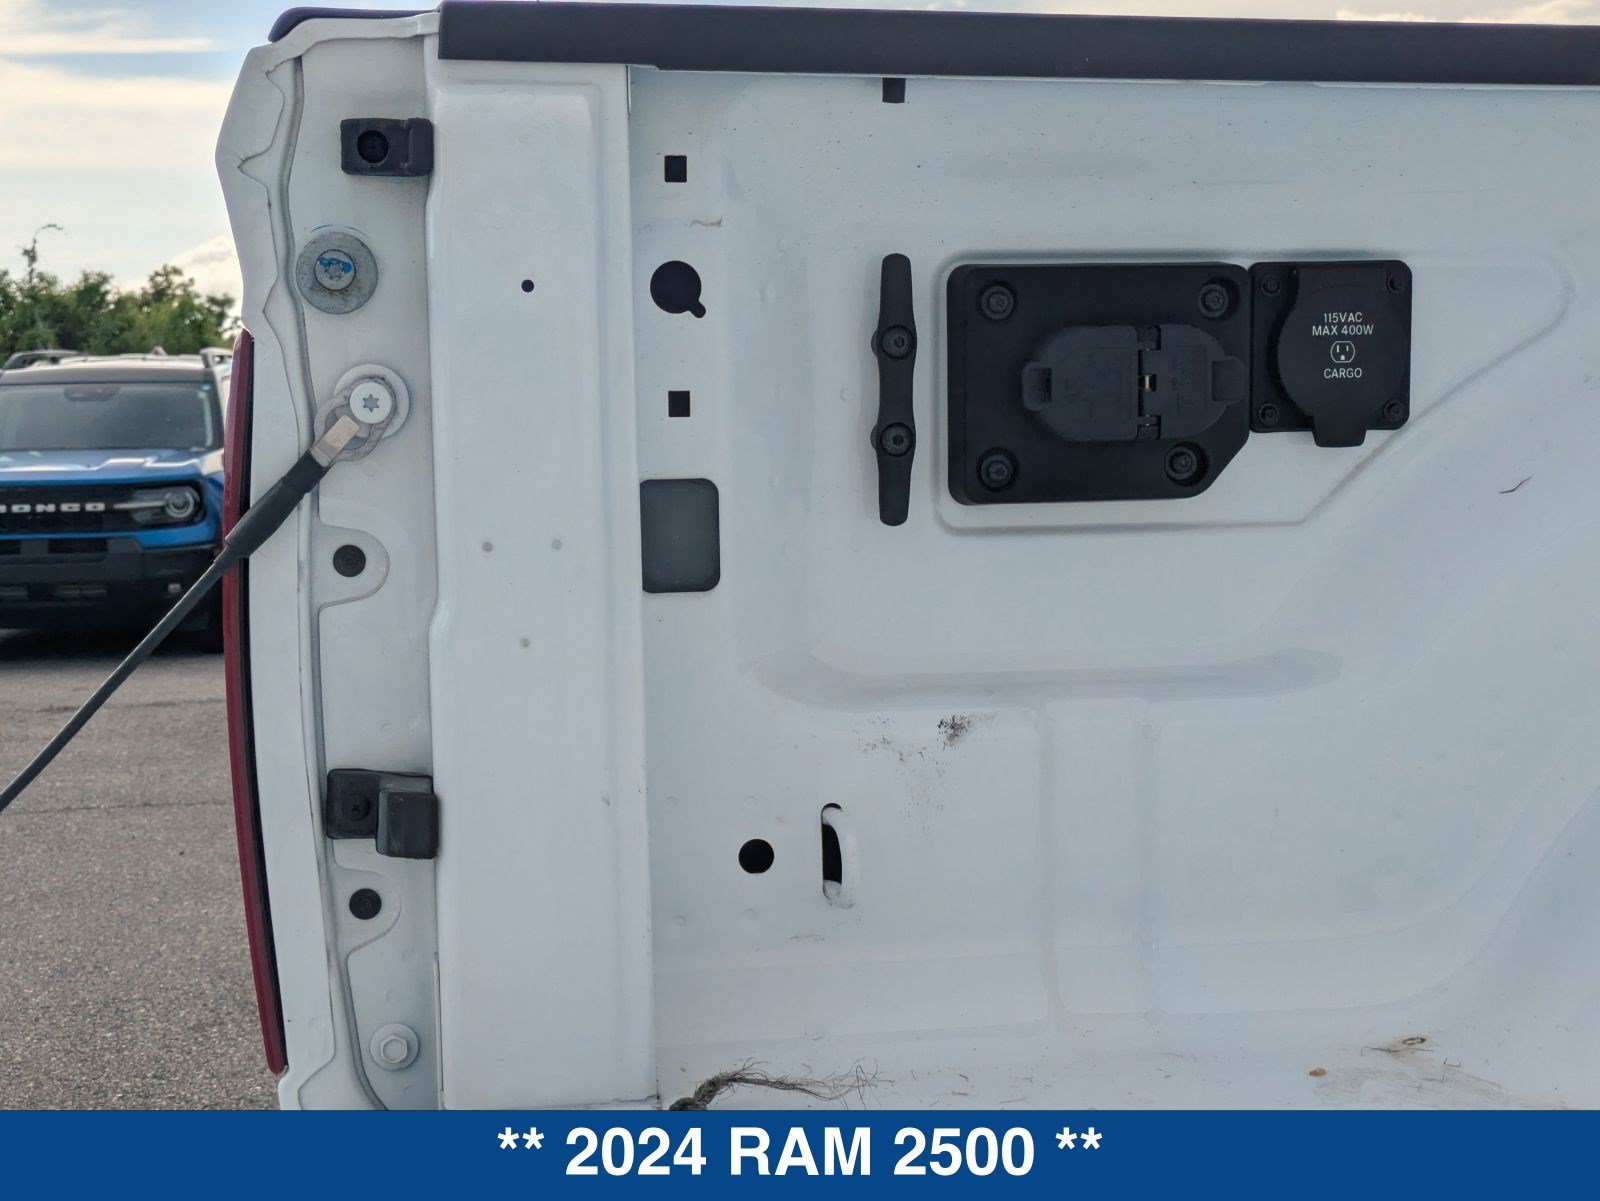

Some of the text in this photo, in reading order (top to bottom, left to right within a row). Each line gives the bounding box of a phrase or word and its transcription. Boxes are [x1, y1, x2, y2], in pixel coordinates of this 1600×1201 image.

[1323, 311, 1363, 323] 115VAC
[1312, 324, 1374, 336] MAX 400W
[1323, 367, 1363, 379] CARGO
